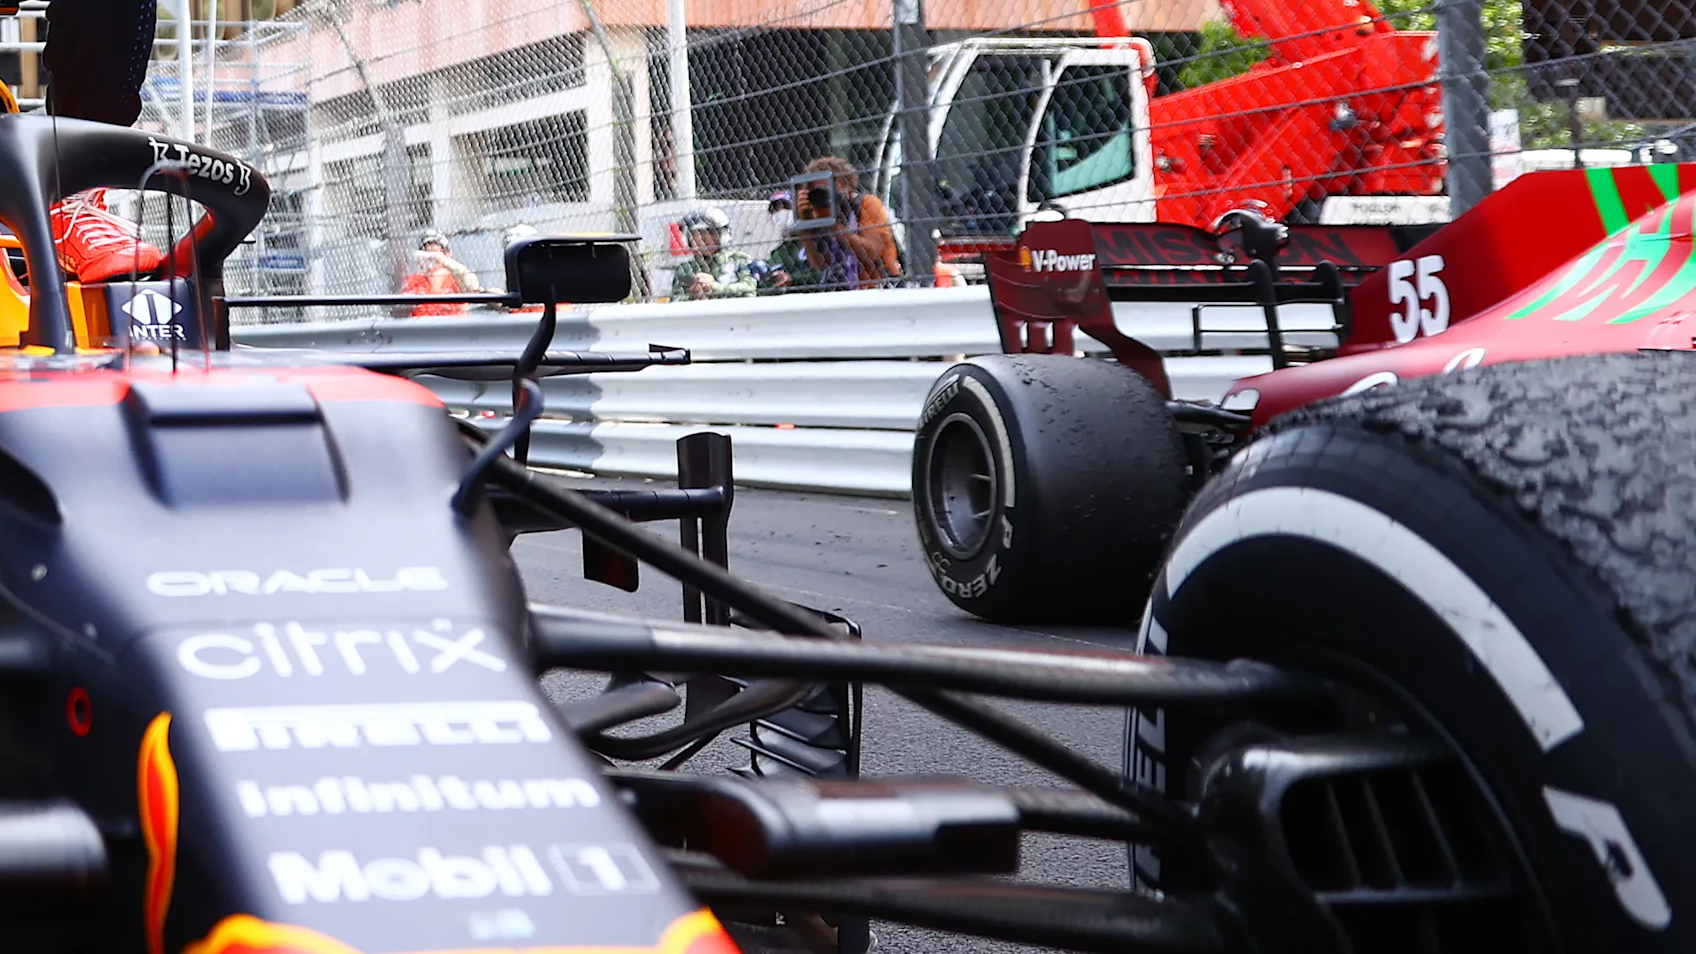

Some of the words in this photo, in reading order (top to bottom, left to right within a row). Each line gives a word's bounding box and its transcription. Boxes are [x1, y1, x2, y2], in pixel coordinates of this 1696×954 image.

[173, 143, 235, 185] Tezos
[1032, 249, 1097, 273] V-Power
[1387, 253, 1451, 344] 55
[145, 566, 450, 597] ORACLE
[177, 618, 508, 681] citrix
[268, 845, 554, 905] Mobil
